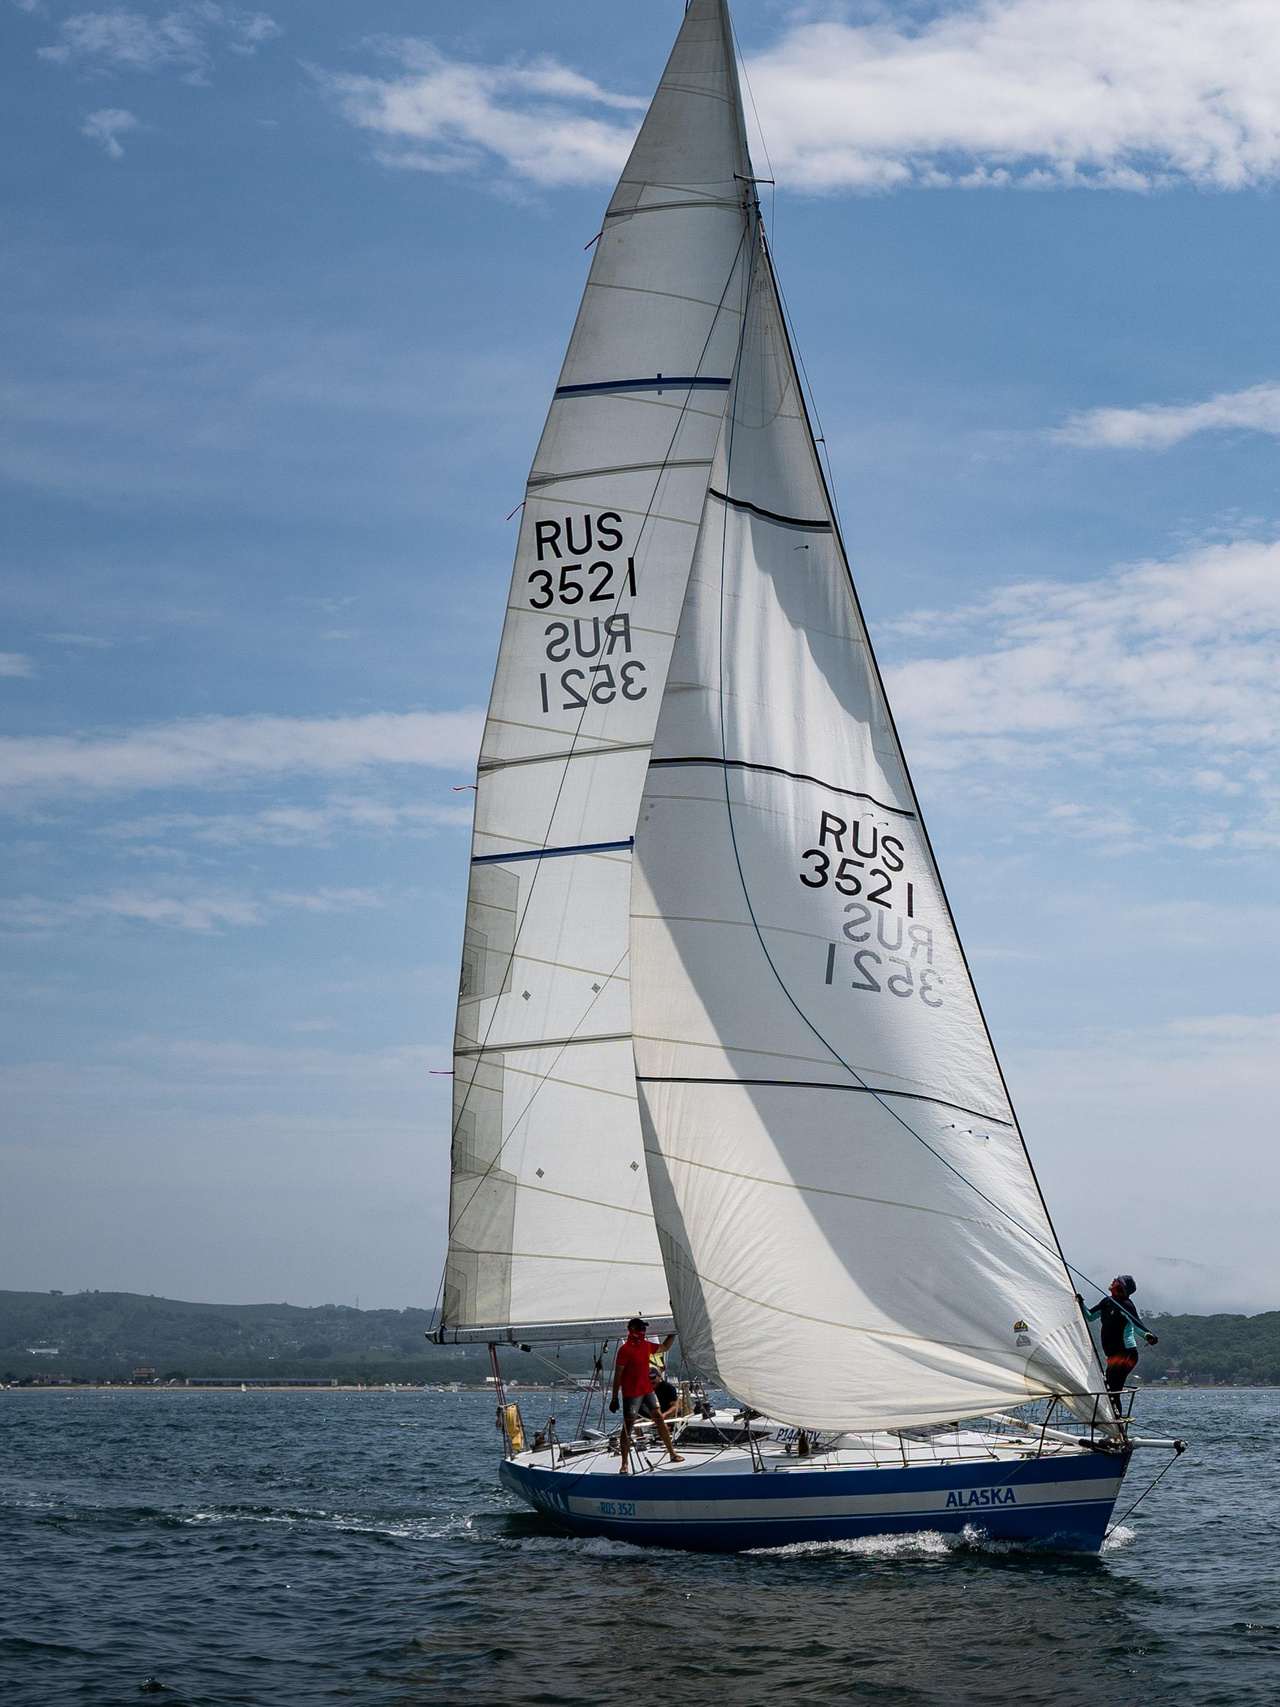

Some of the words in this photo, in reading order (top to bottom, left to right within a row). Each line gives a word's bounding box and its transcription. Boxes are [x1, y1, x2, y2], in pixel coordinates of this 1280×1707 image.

[535, 511, 623, 561] RUS
[527, 556, 637, 609] 3521
[818, 810, 905, 872] RUS
[799, 849, 914, 918] 3521
[601, 1502, 616, 1515] RUS
[618, 1502, 636, 1516] 3521
[946, 1487, 1017, 1507] ALASKA
